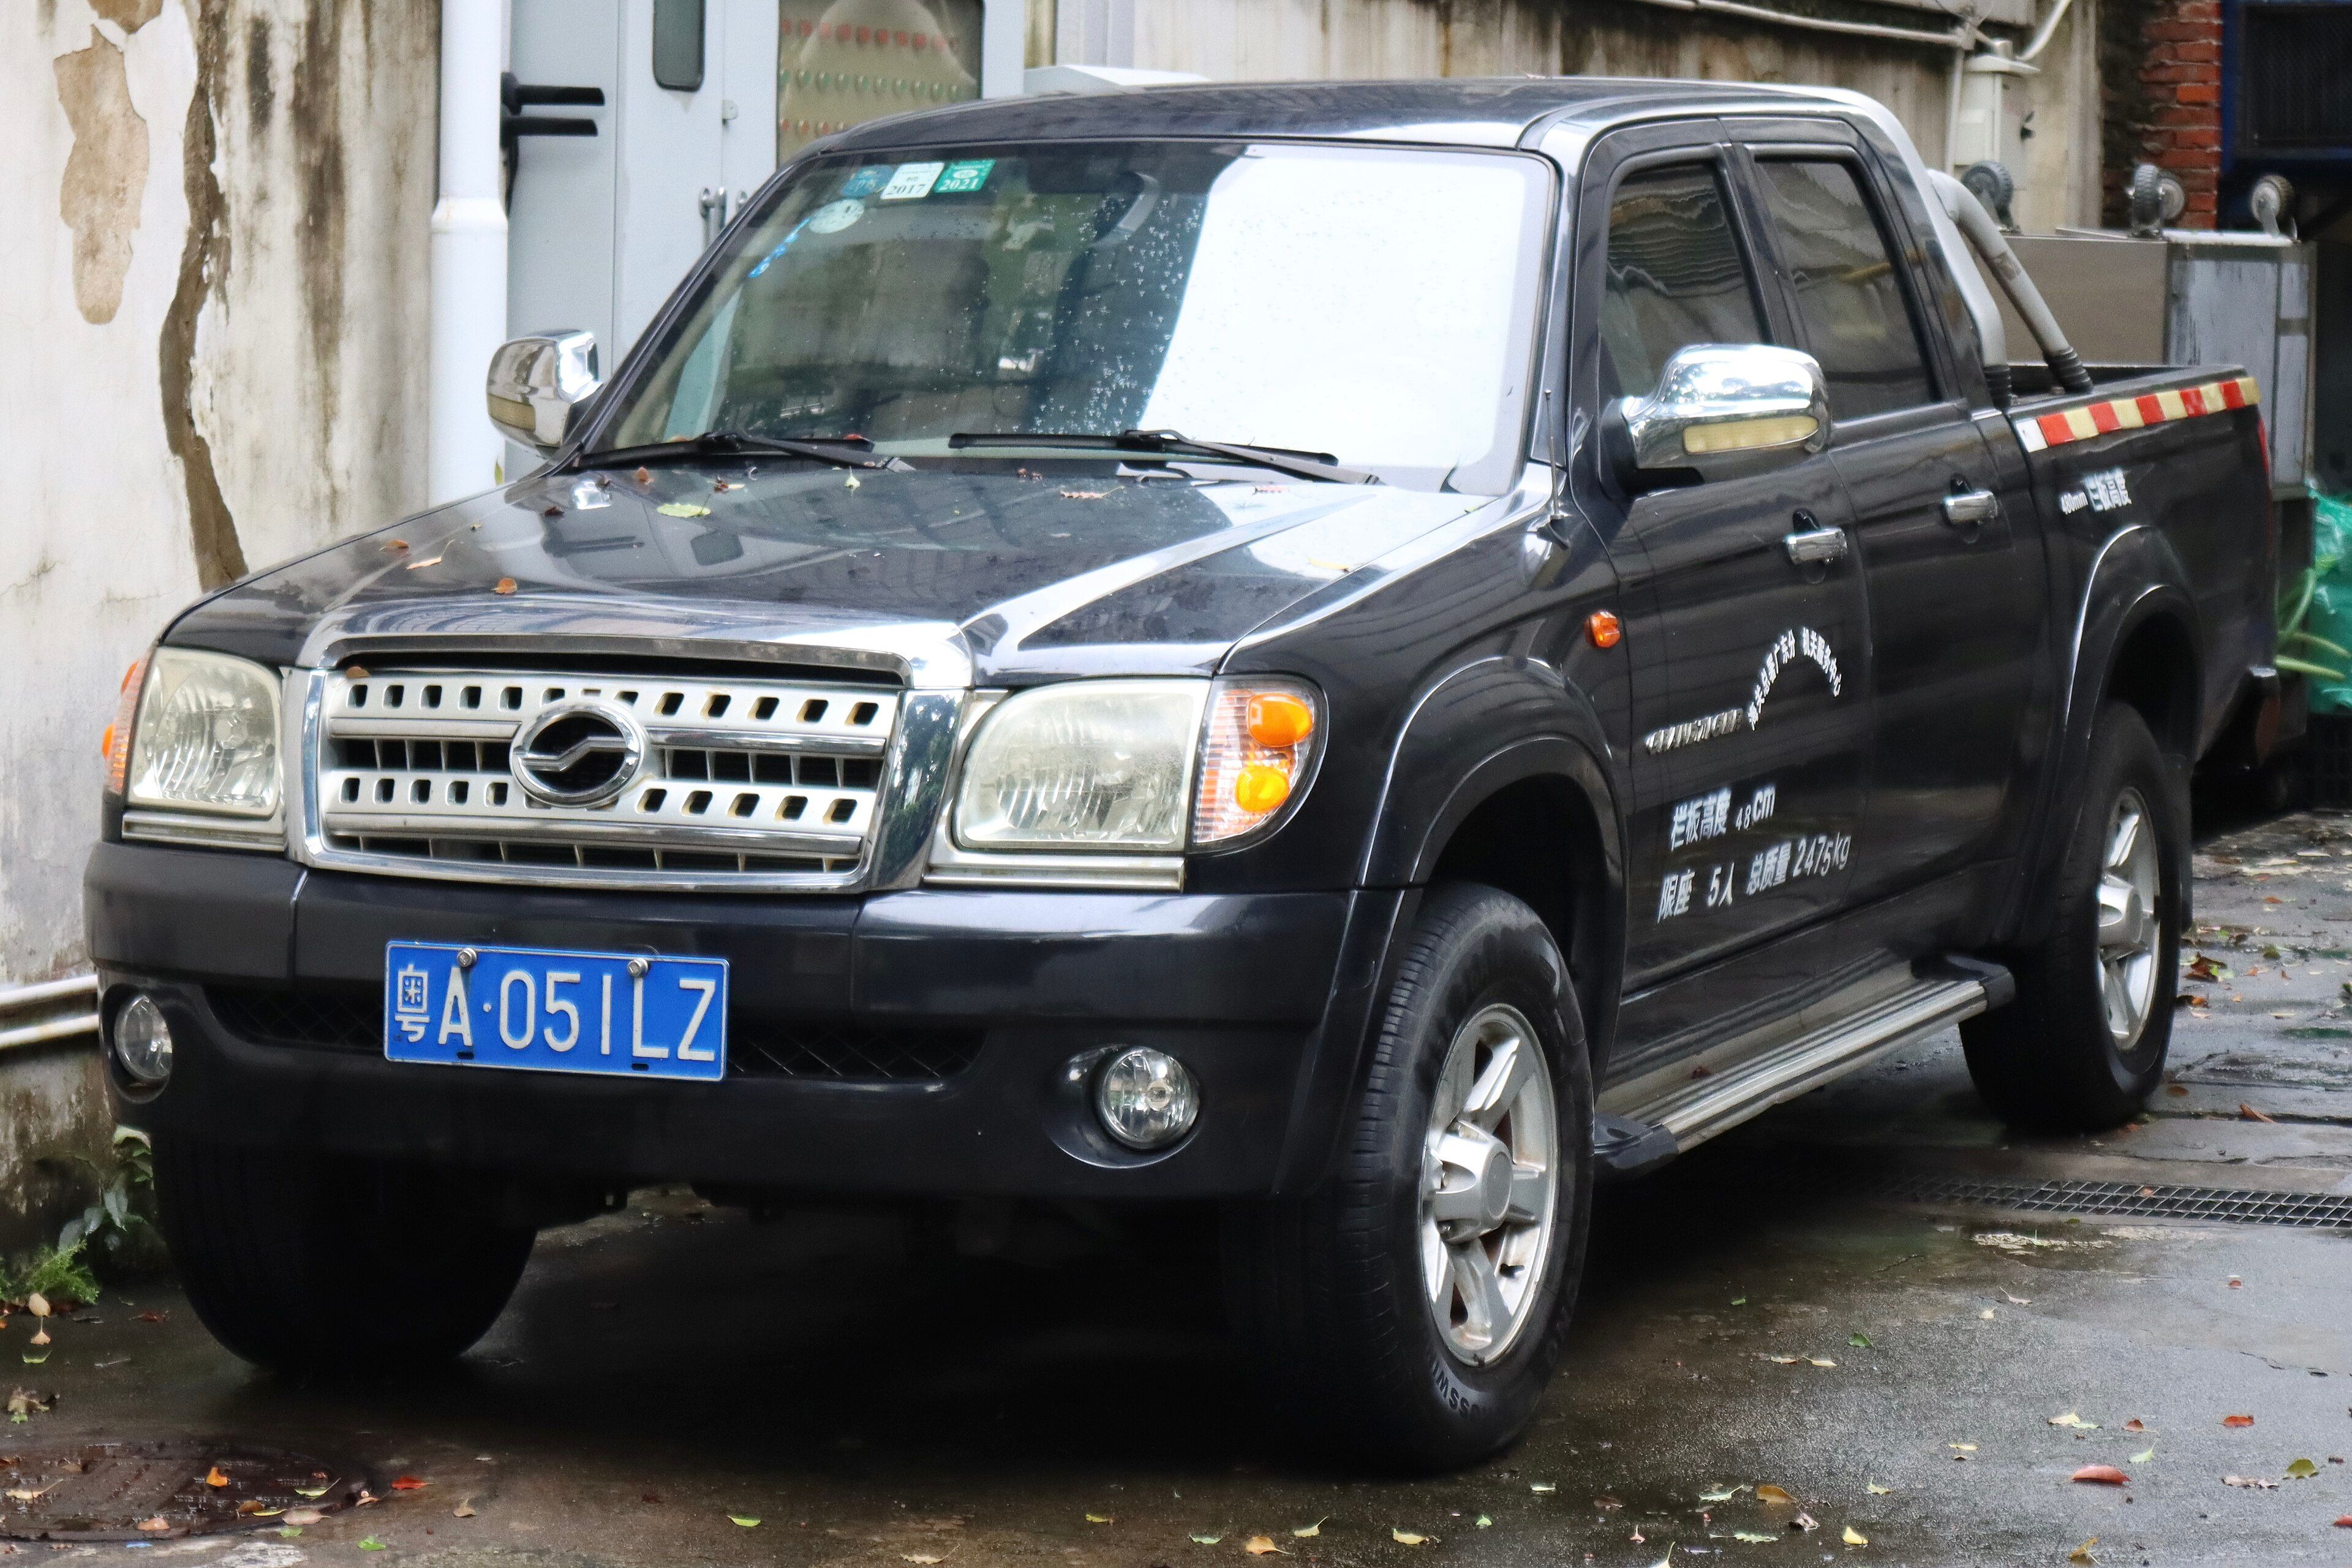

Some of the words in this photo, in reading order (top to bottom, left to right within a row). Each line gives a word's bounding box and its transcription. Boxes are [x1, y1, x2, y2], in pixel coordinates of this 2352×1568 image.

[886, 183, 927, 196] 2017
[941, 178, 980, 190] 2021
[1671, 788, 1732, 851] 栏板高度
[1657, 869, 1695, 924] 限座
